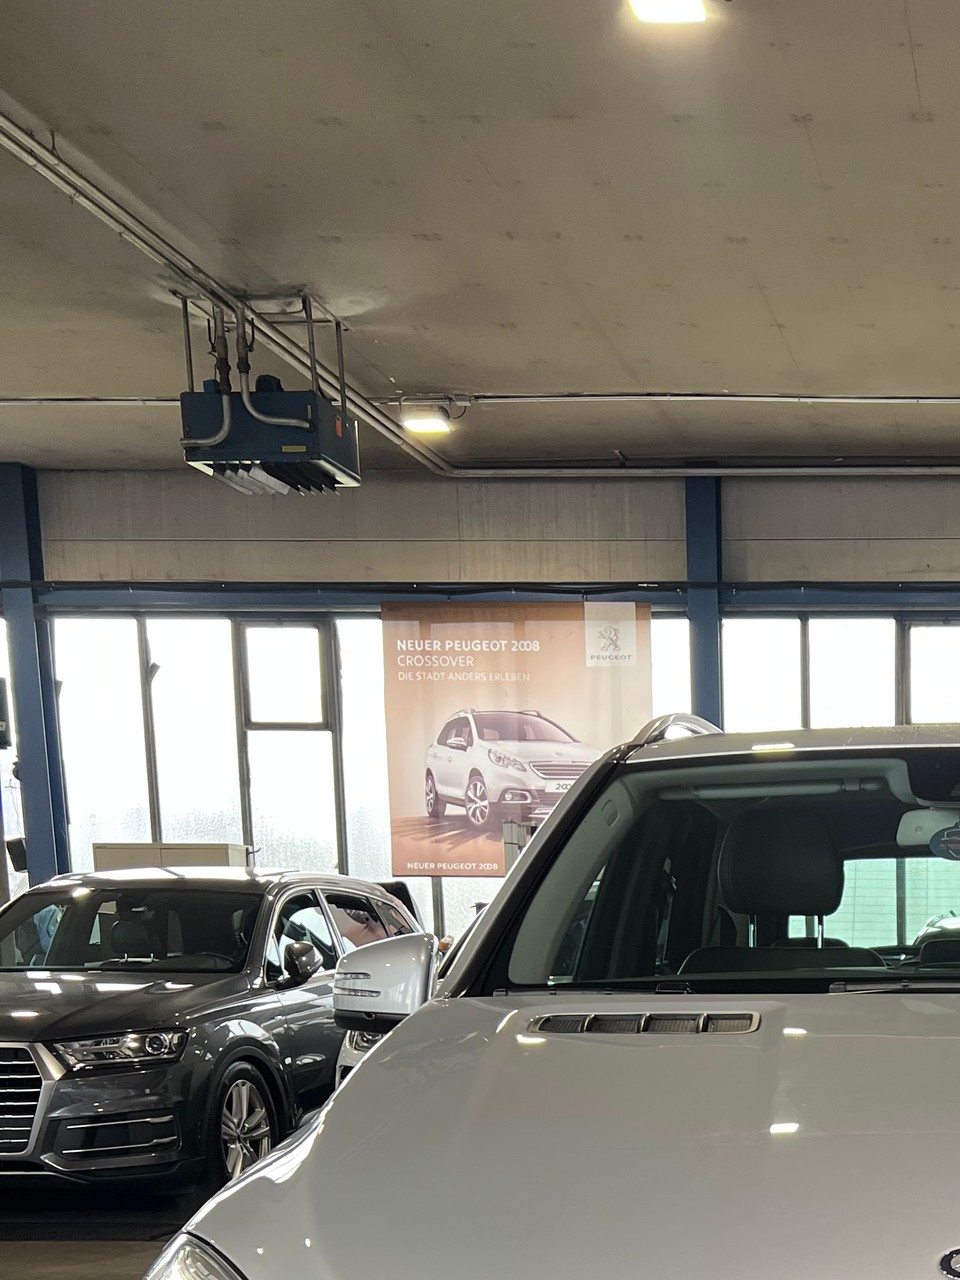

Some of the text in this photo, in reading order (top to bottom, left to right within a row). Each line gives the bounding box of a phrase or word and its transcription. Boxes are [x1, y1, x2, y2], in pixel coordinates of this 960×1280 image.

[397, 640, 540, 652] NEUER PEUGEOT 2008
[397, 655, 474, 667] CROSSOVER
[398, 672, 530, 682] DIE STADT ANDERS ERLEBEN
[555, 783, 572, 791] 200
